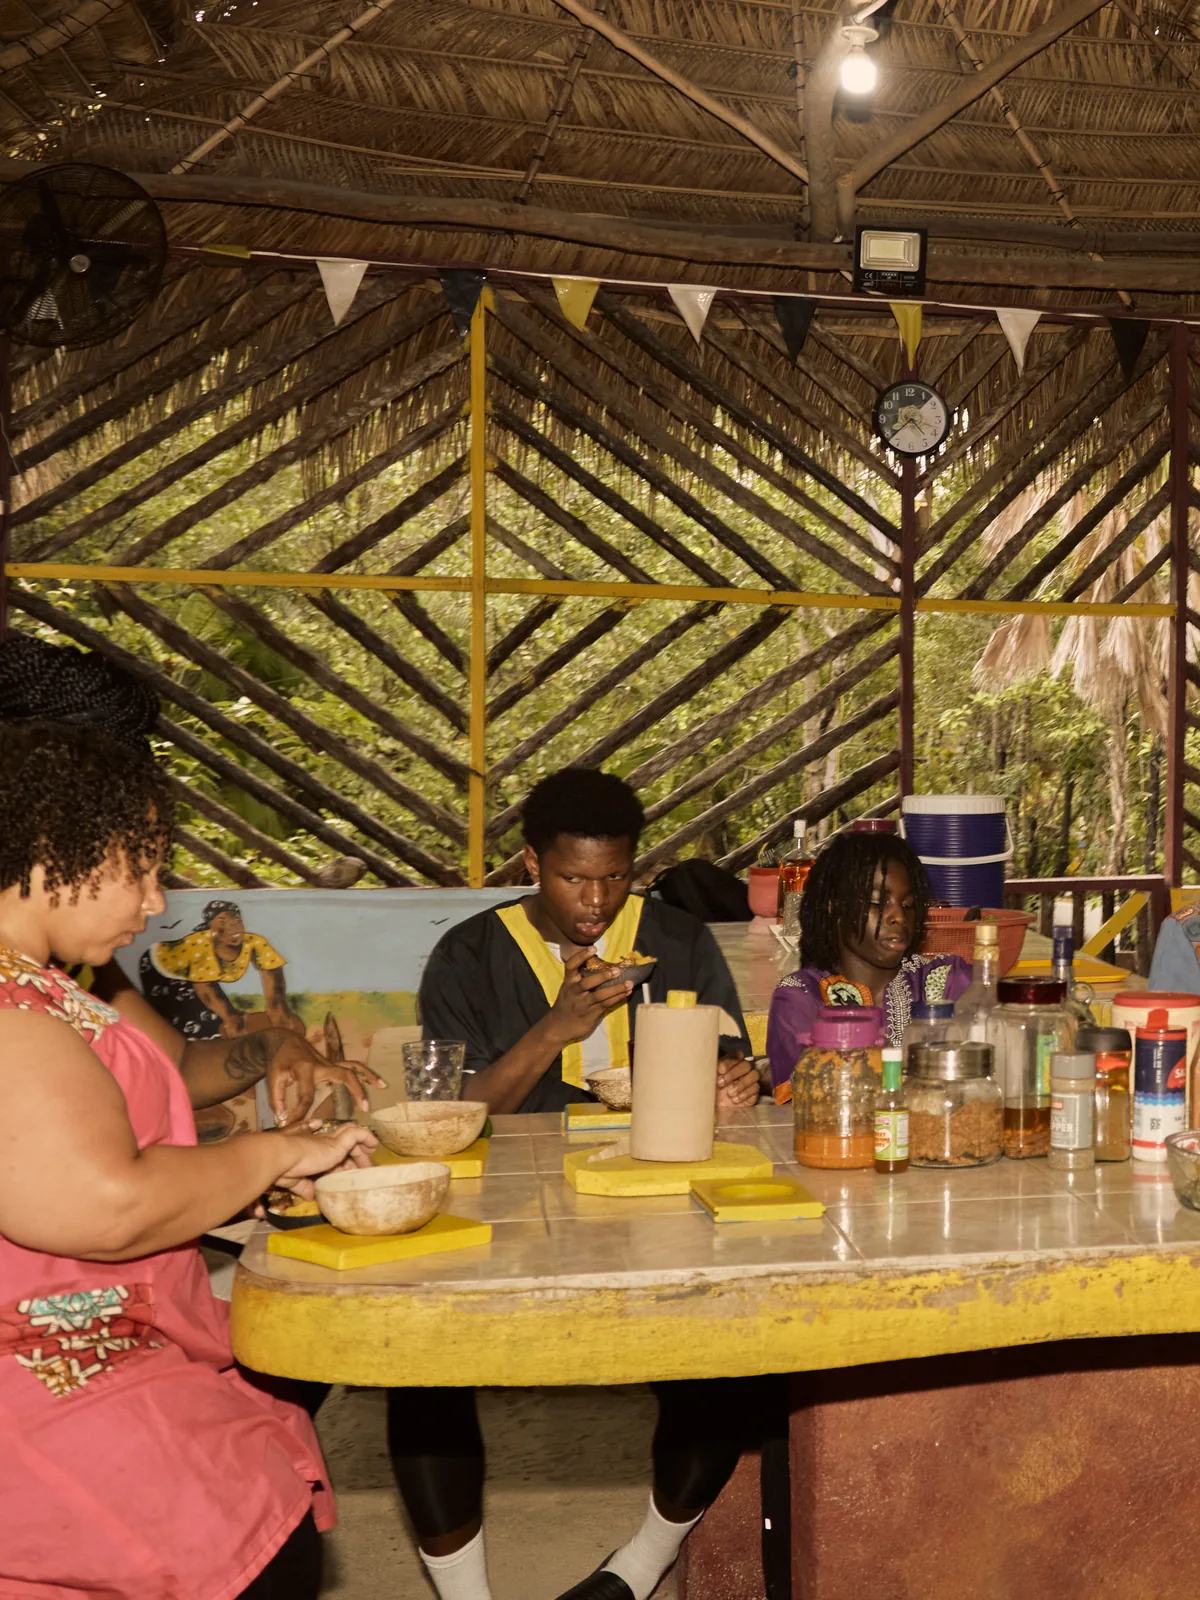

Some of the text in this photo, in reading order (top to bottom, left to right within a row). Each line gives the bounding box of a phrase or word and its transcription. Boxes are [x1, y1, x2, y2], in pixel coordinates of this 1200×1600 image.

[892, 392, 899, 401] 11
[905, 388, 915, 397] 12
[883, 401, 893, 410] 10
[930, 401, 937, 410] 2
[878, 413, 886, 423] 9
[935, 415, 942, 425] 3
[884, 429, 891, 438] 8
[930, 428, 938, 438] 4
[895, 438, 900, 447] 7
[908, 442, 915, 452] 6
[921, 438, 928, 447] 5
